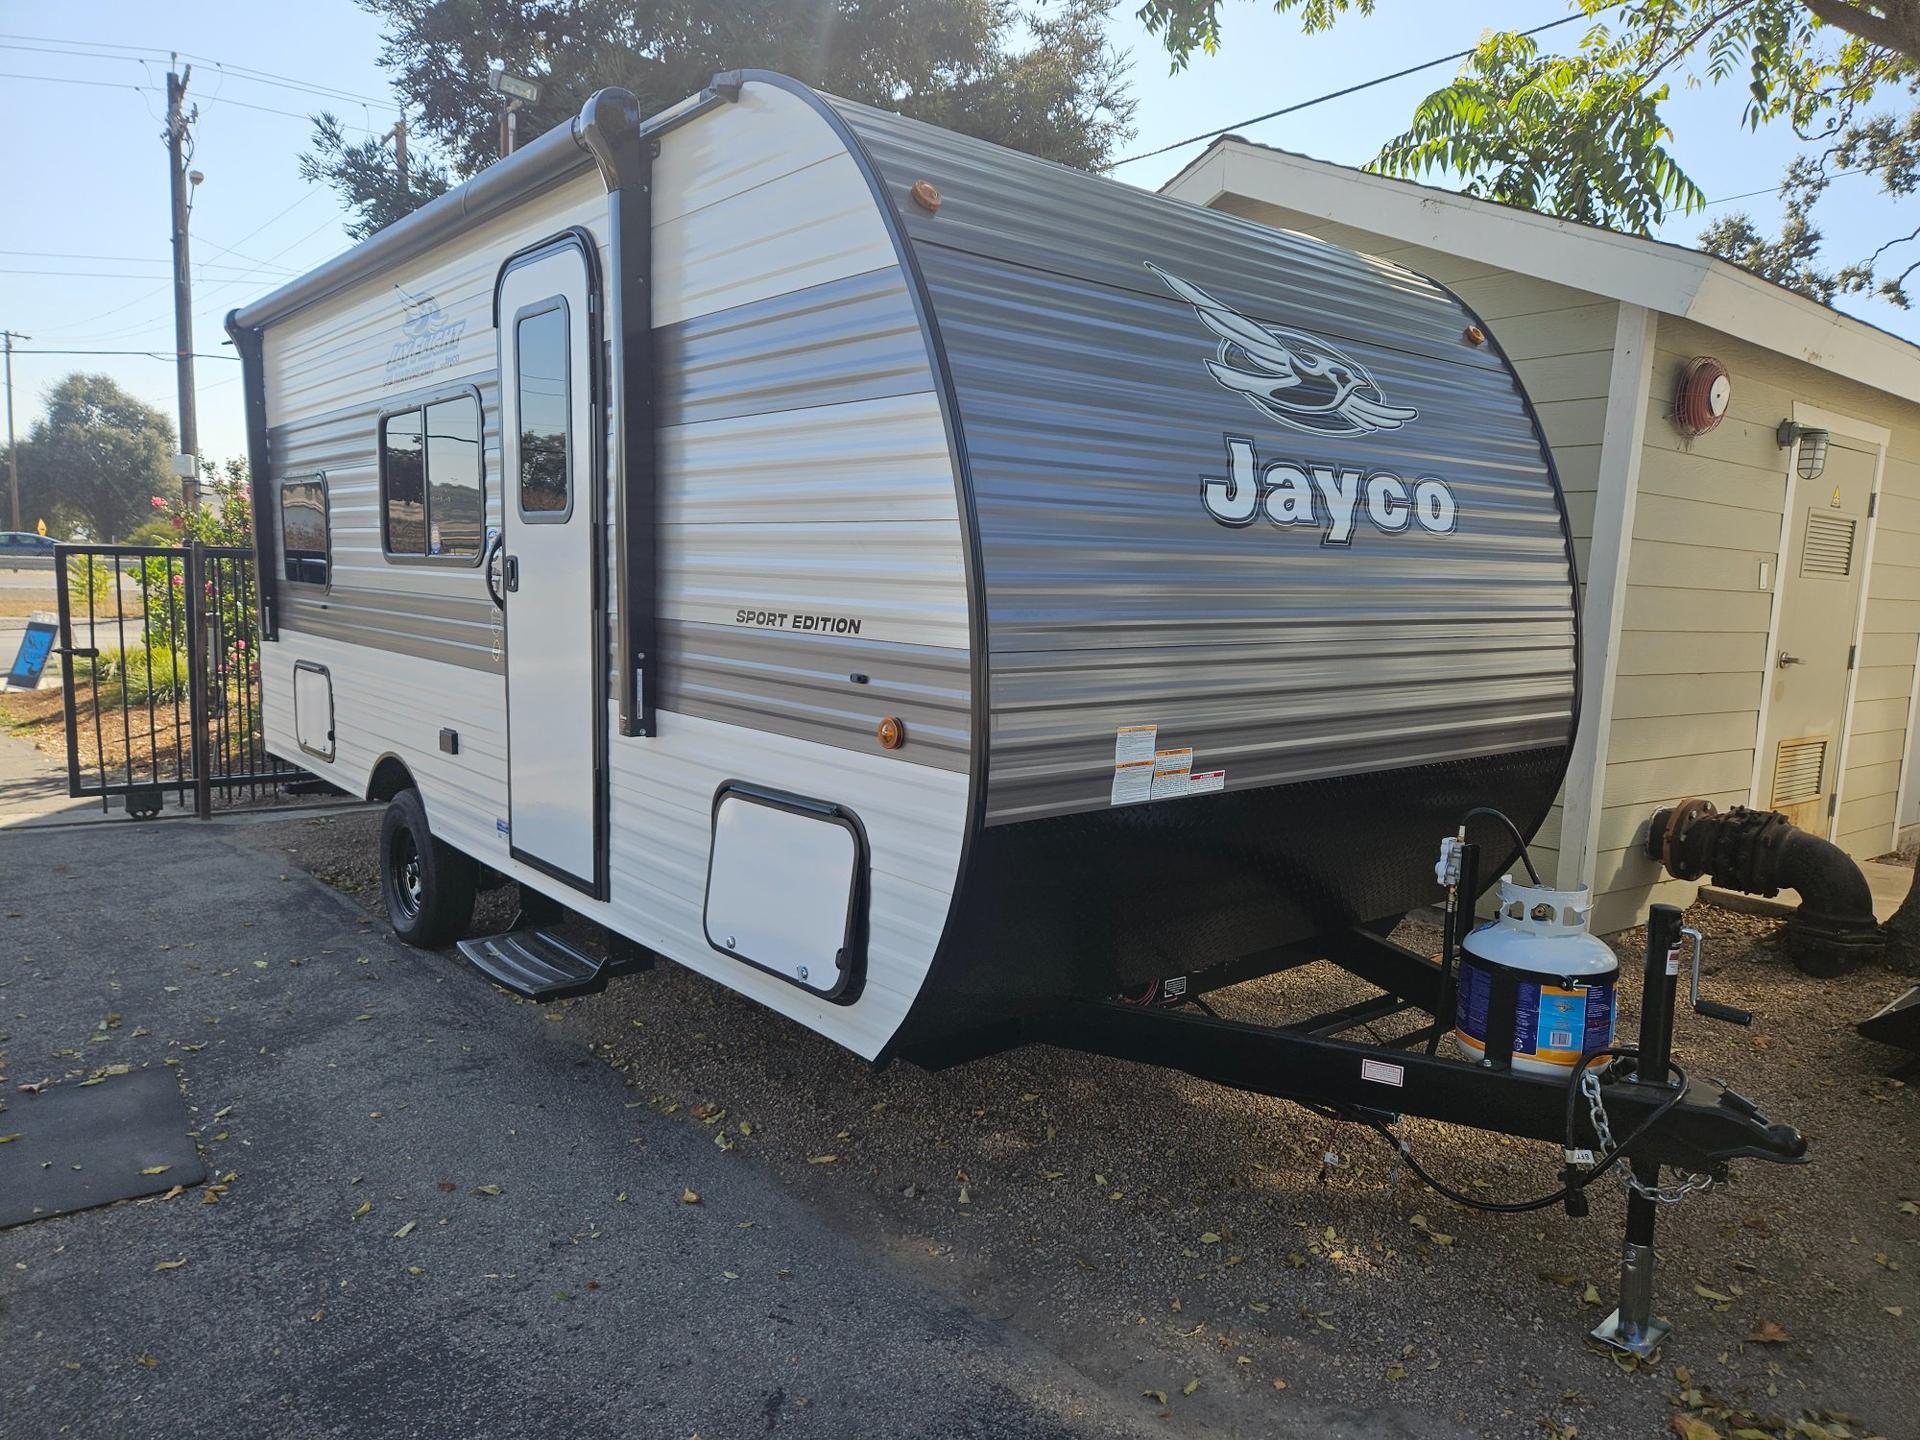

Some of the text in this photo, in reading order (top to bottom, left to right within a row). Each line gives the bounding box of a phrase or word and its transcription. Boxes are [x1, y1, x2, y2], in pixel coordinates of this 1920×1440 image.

[1200, 433, 1457, 549] Jayco
[736, 610, 863, 635] SPORT EDITION
